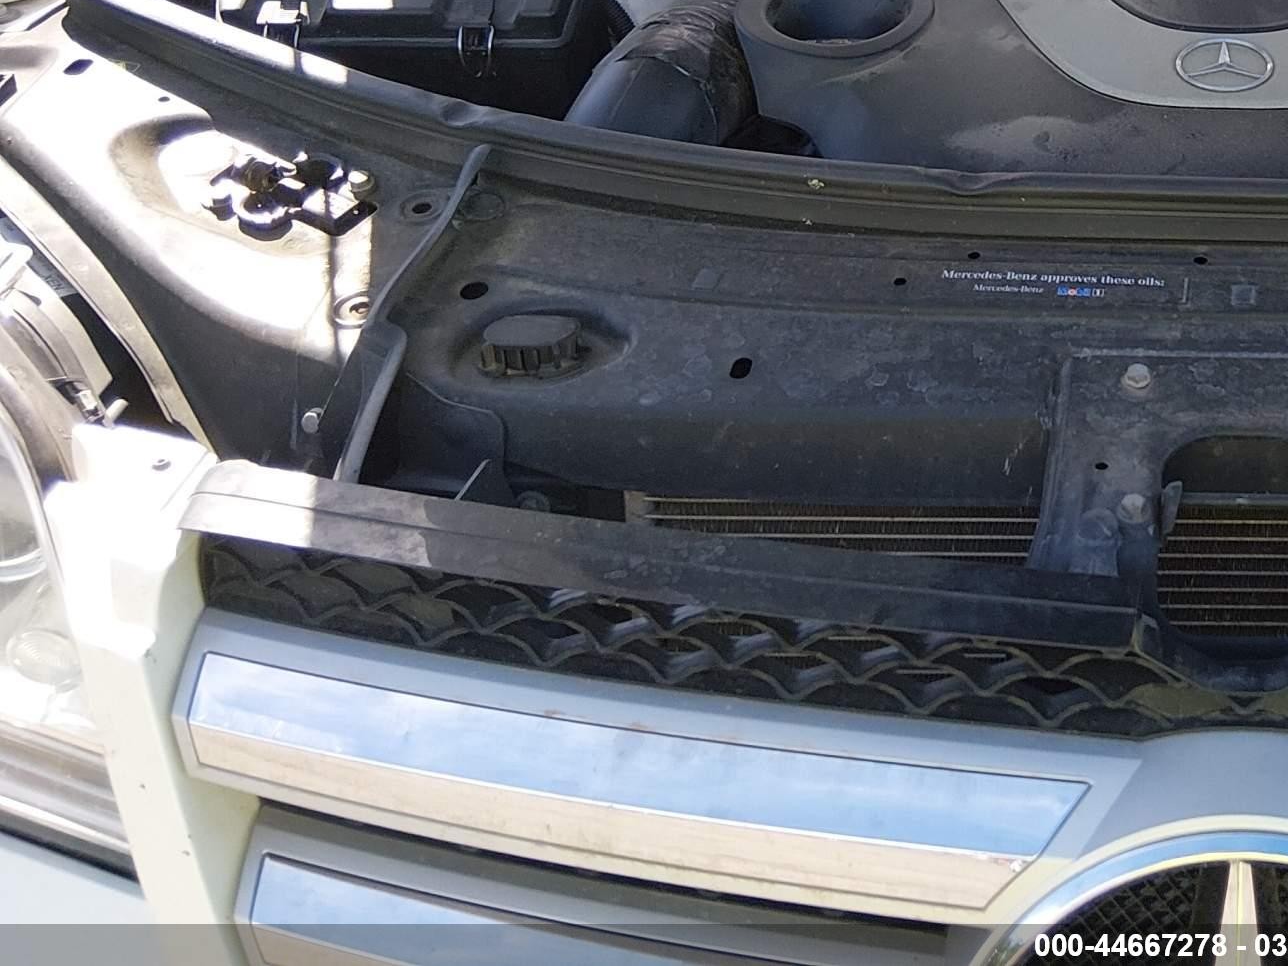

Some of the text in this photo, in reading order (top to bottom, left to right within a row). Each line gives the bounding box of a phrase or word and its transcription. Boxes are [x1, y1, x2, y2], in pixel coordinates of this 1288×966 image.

[942, 269, 1165, 287] Mercedes-Benz approves these oils:
[973, 284, 1044, 294] Mercedes-Benz
